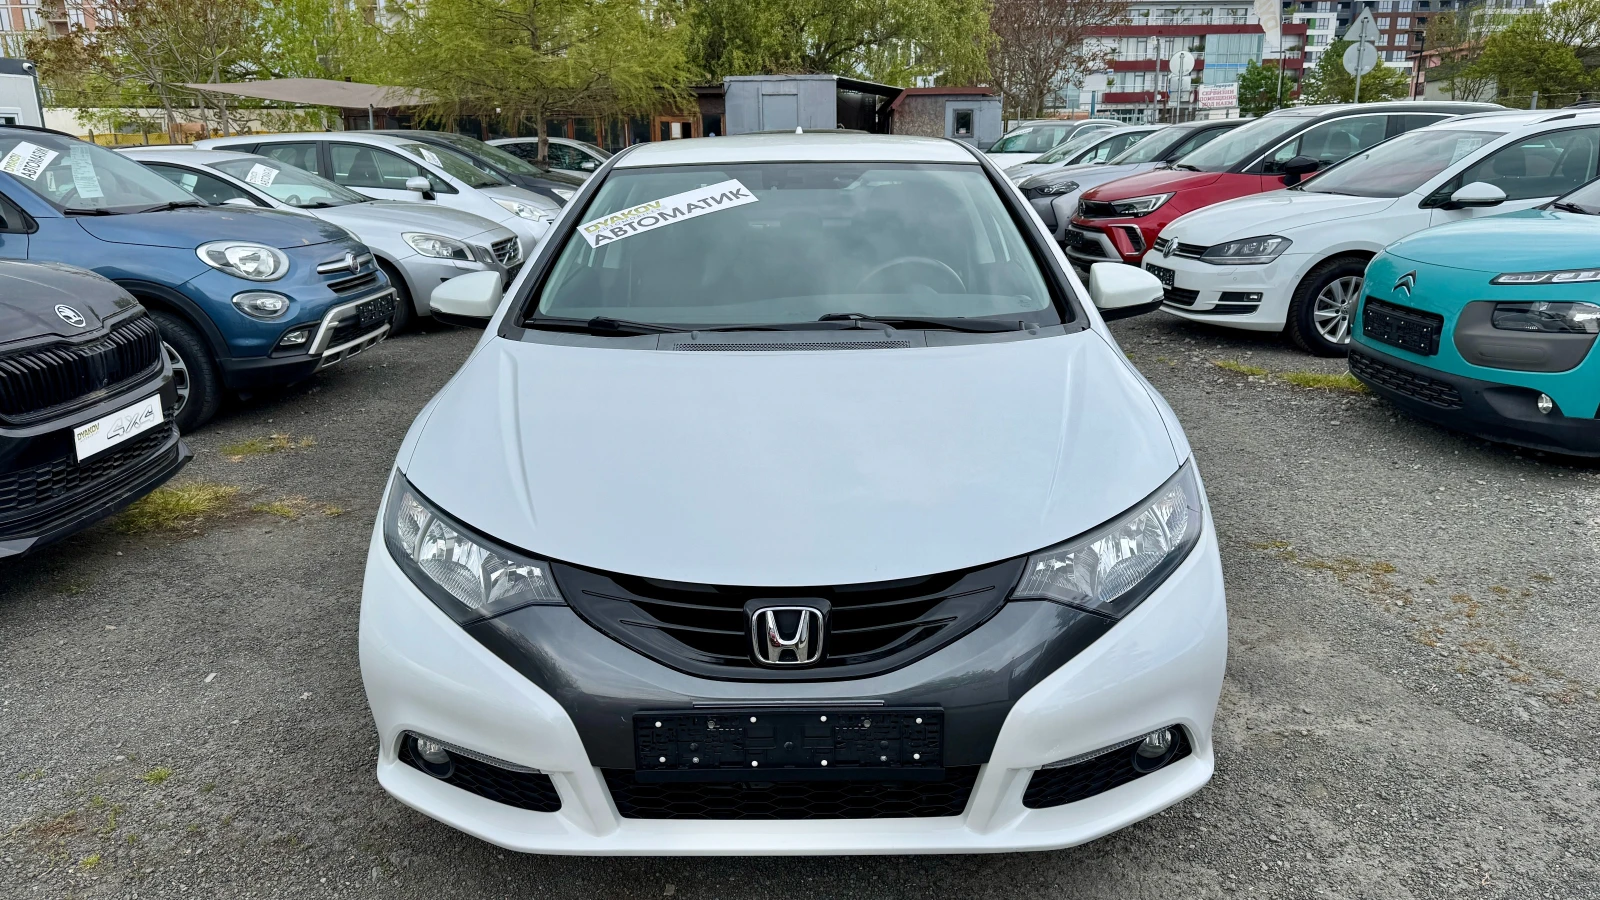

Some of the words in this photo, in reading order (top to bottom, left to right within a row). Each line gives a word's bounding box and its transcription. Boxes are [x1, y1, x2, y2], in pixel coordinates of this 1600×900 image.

[583, 201, 662, 234] DYAKOV
[594, 187, 750, 247] АВТОМАТИК
[76, 422, 100, 441] DYAKOV
